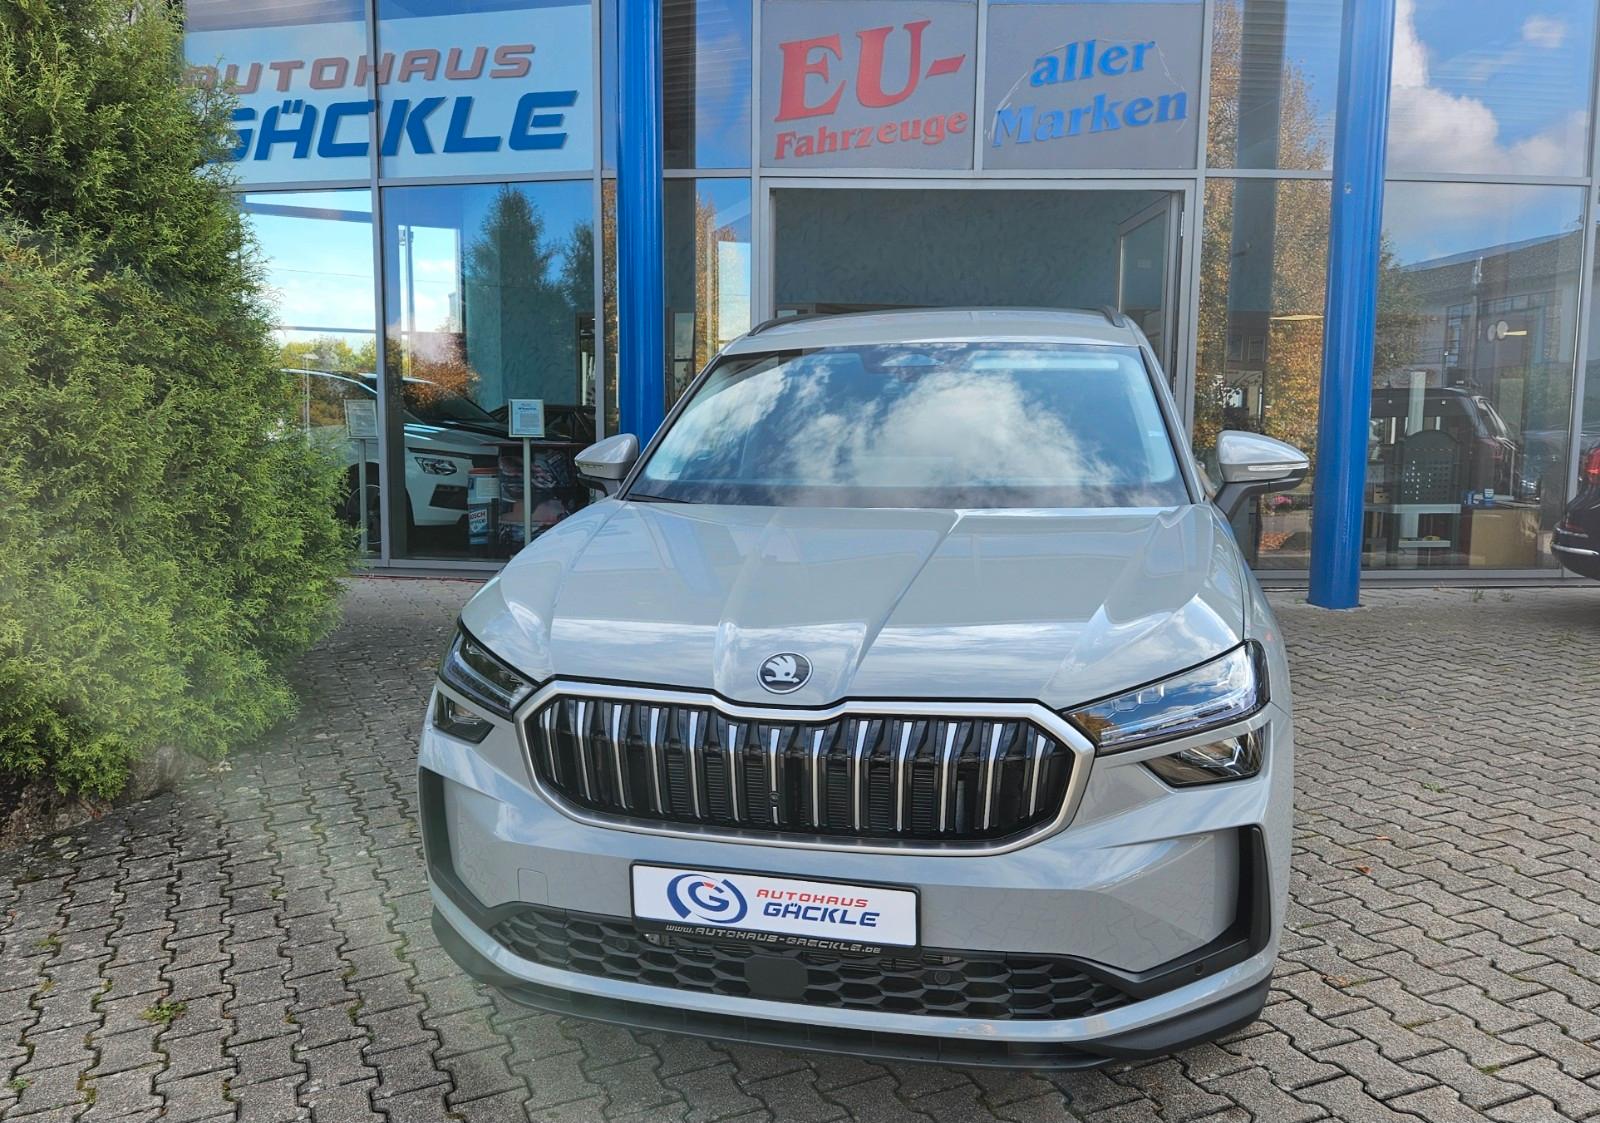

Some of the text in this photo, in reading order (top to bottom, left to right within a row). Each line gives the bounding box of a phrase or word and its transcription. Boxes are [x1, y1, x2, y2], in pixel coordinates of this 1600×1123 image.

[774, 20, 966, 123] EU-
[1029, 39, 1156, 88] aller
[774, 111, 968, 160] Fahrzeuge
[992, 91, 1188, 148] Marken
[756, 889, 868, 908] AUTOHAUS
[763, 902, 880, 927] GÄCKLE
